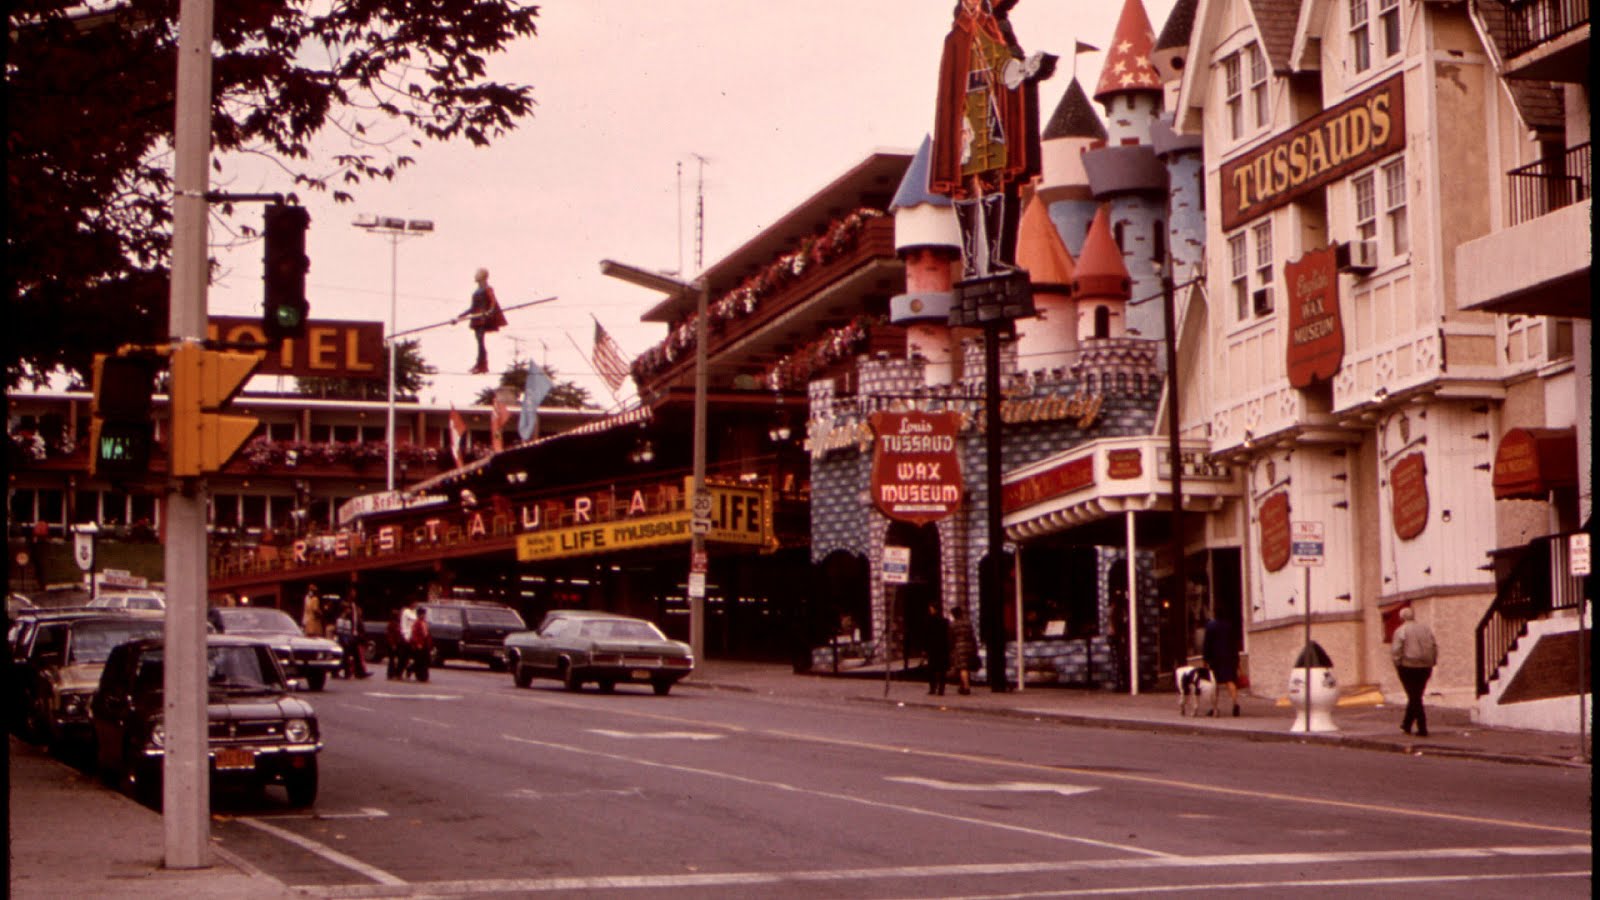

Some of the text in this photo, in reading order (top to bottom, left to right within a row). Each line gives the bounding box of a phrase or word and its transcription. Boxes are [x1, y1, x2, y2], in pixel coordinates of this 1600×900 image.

[1233, 92, 1391, 211] TUSSAUD'S
[1301, 296, 1325, 319] WAX
[1294, 315, 1335, 345] MUSEUM
[899, 417, 933, 434] Louis
[101, 437, 134, 460] WAL
[881, 434, 953, 452] TUSSAUD
[897, 462, 941, 480] WAX
[881, 484, 958, 502] MUSEUM
[560, 528, 606, 550] LIFE
